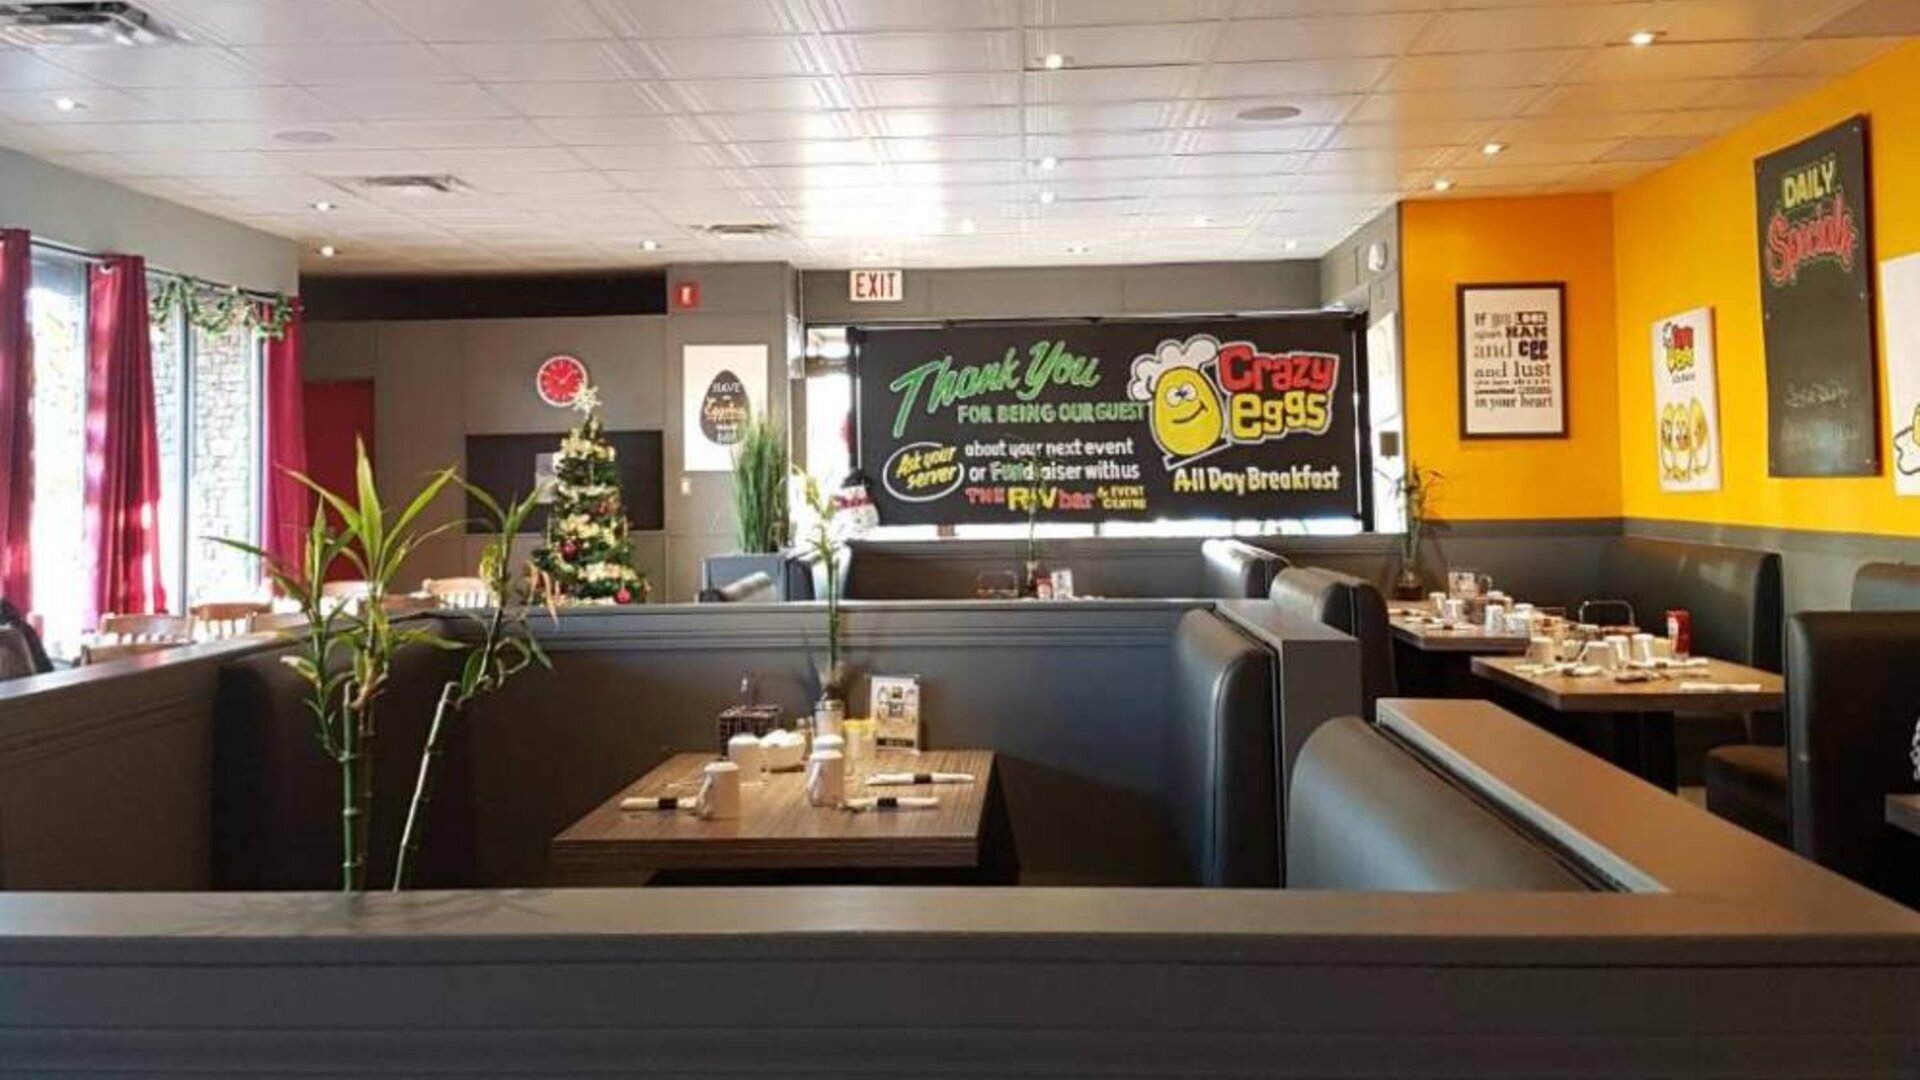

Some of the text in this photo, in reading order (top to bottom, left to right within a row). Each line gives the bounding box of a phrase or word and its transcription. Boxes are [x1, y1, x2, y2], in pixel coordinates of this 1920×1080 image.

[1784, 161, 1836, 208] DAILY
[855, 272, 896, 298] EXIT
[1219, 344, 1335, 392] Crazy
[1474, 361, 1551, 378] and lust
[890, 340, 1099, 438] Thank You
[957, 402, 1145, 424] FOR BEING OUR GUEST
[1231, 391, 1328, 439] eggs
[965, 438, 1134, 459] about your next event
[906, 466, 957, 488] server
[969, 460, 1140, 482] or Fundaiser with us
[1173, 464, 1340, 495] All Day Breakfast
[1110, 485, 1145, 497] EVENT
